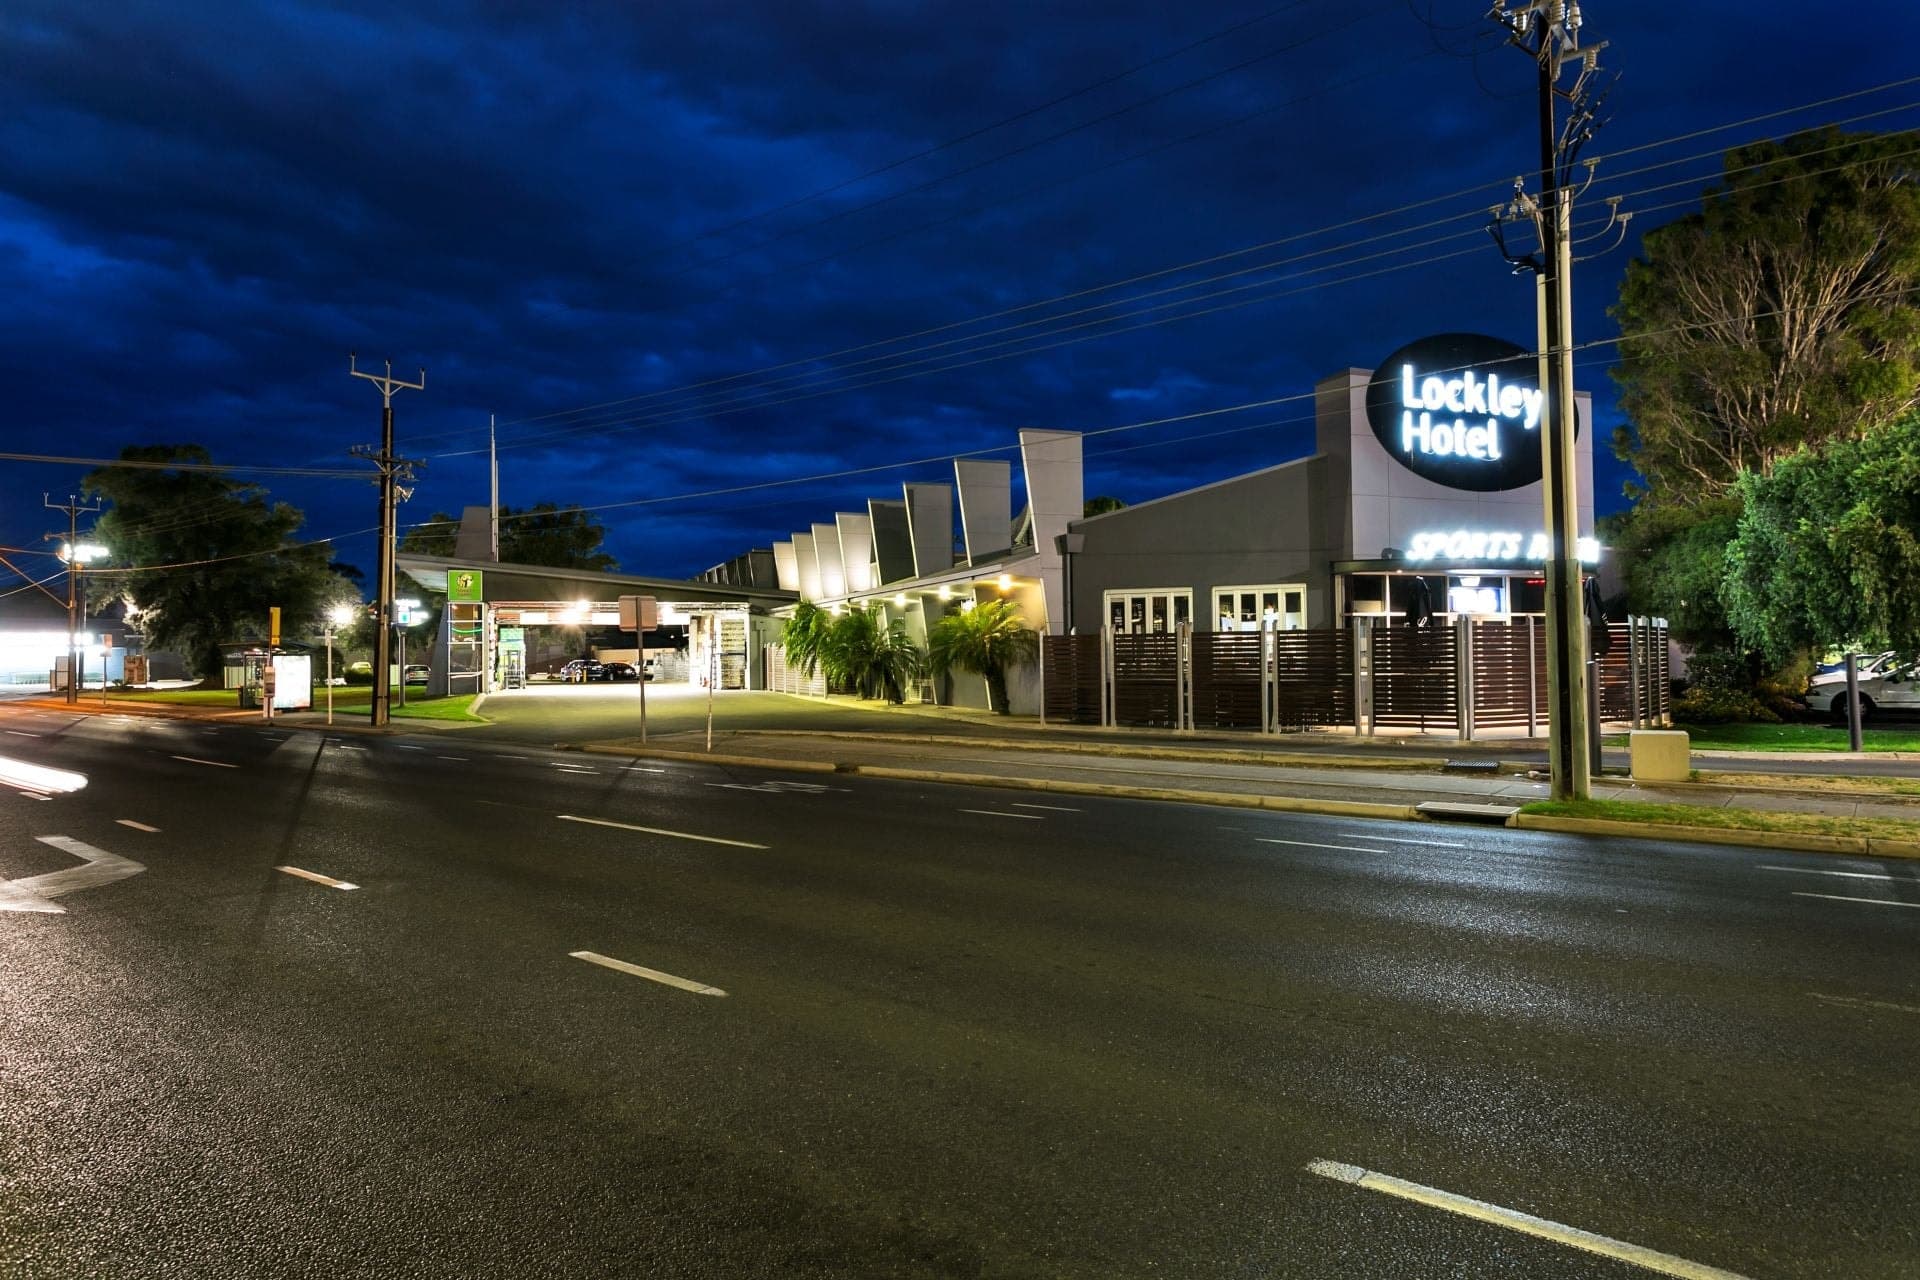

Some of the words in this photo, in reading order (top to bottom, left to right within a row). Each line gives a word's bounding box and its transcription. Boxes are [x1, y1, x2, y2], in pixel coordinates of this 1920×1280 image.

[1402, 364, 1542, 429] Lockley
[1402, 410, 1501, 459] Hotel
[1406, 531, 1522, 561] SPORTS
